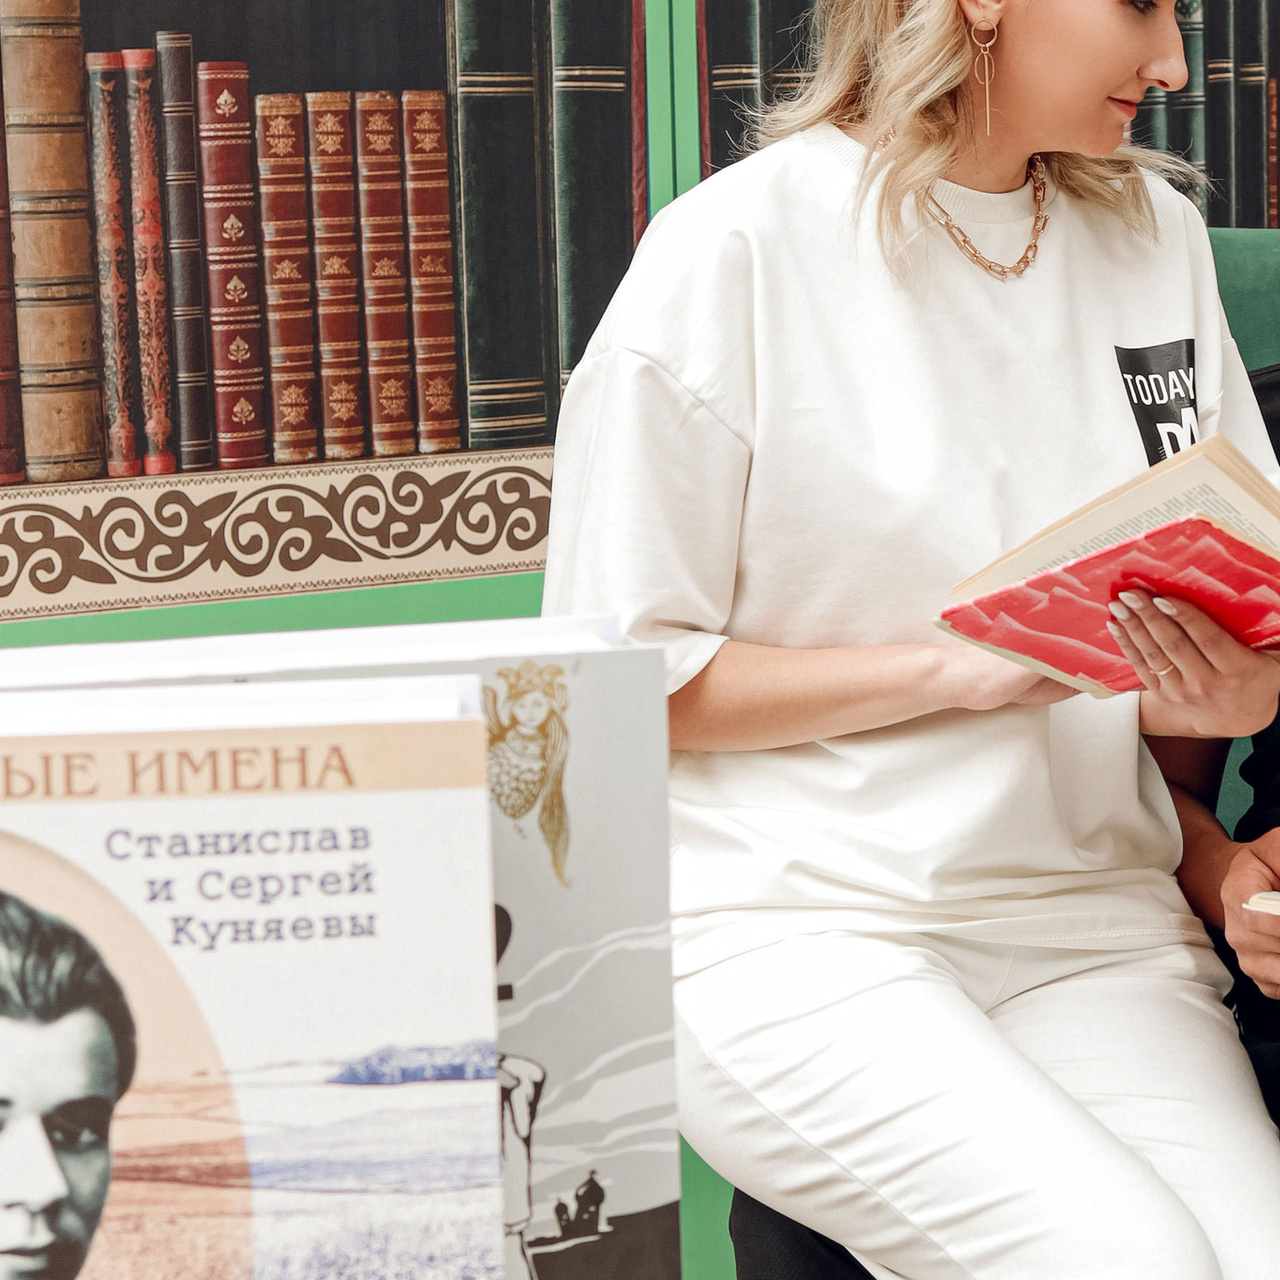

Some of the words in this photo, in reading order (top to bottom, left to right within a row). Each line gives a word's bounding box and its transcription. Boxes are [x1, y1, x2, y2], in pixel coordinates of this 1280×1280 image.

[1123, 367, 1195, 406] TODAY
[126, 744, 357, 796] ИМЕНА
[105, 826, 371, 860] Станислав
[148, 879, 174, 902] и
[198, 863, 374, 904] Сергей
[171, 914, 375, 951] Куняевы
